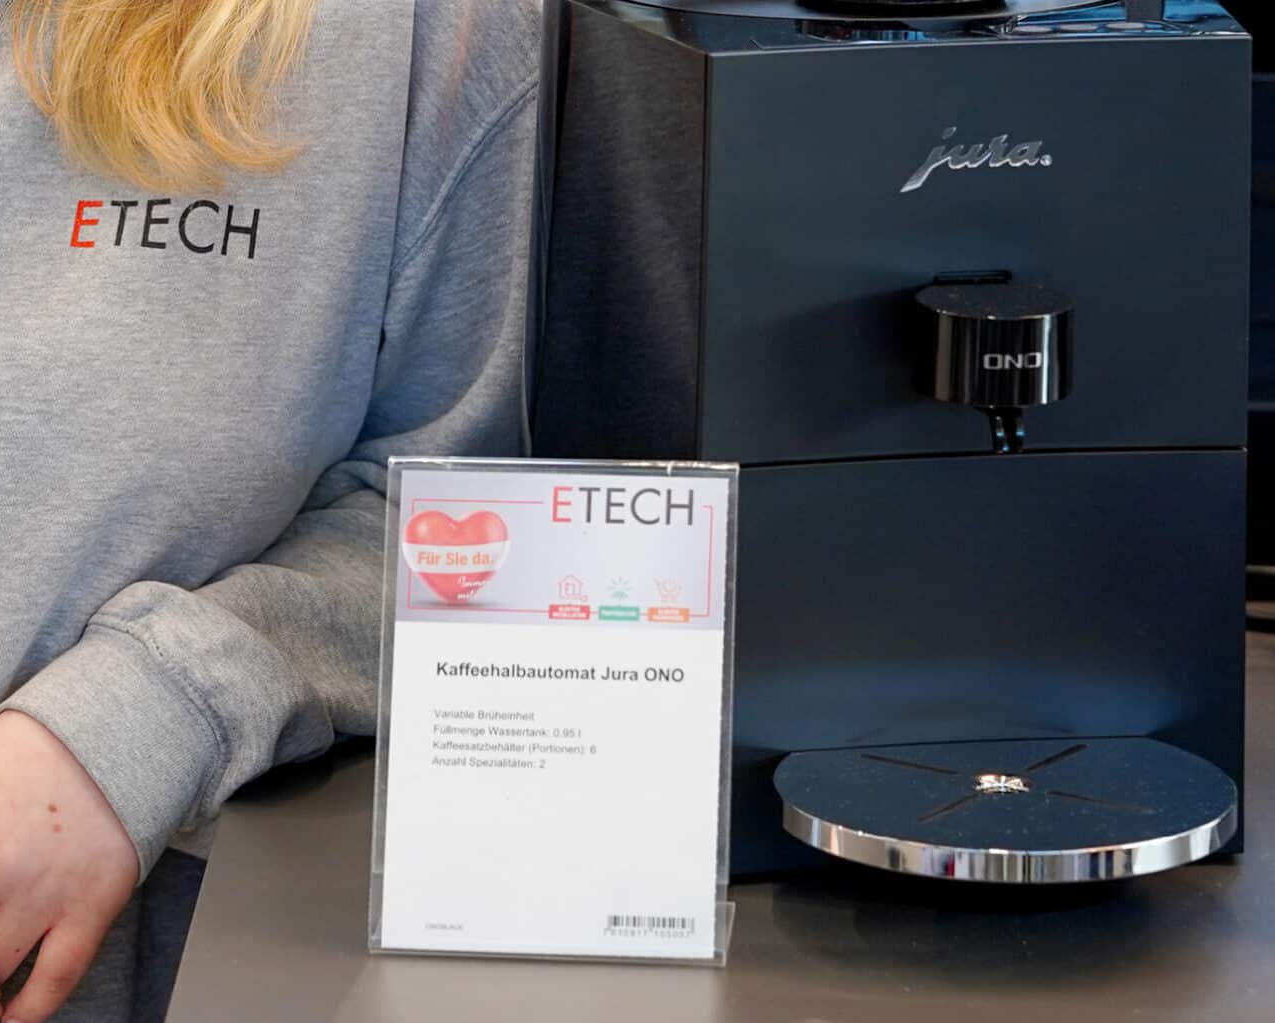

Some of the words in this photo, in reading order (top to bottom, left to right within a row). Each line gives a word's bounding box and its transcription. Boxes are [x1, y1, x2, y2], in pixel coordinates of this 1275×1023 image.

[70, 198, 260, 259] ETECH
[983, 352, 1043, 370] ONO
[552, 486, 694, 526] ETECH
[417, 551, 440, 565] Für
[445, 552, 469, 566] Sie
[436, 661, 596, 681] Kaffeehalbautomat
[600, 666, 639, 681] Jura
[644, 667, 685, 683] ONO
[434, 709, 475, 720] Variable
[431, 756, 467, 766] Anzahl
[538, 759, 546, 769] 2
